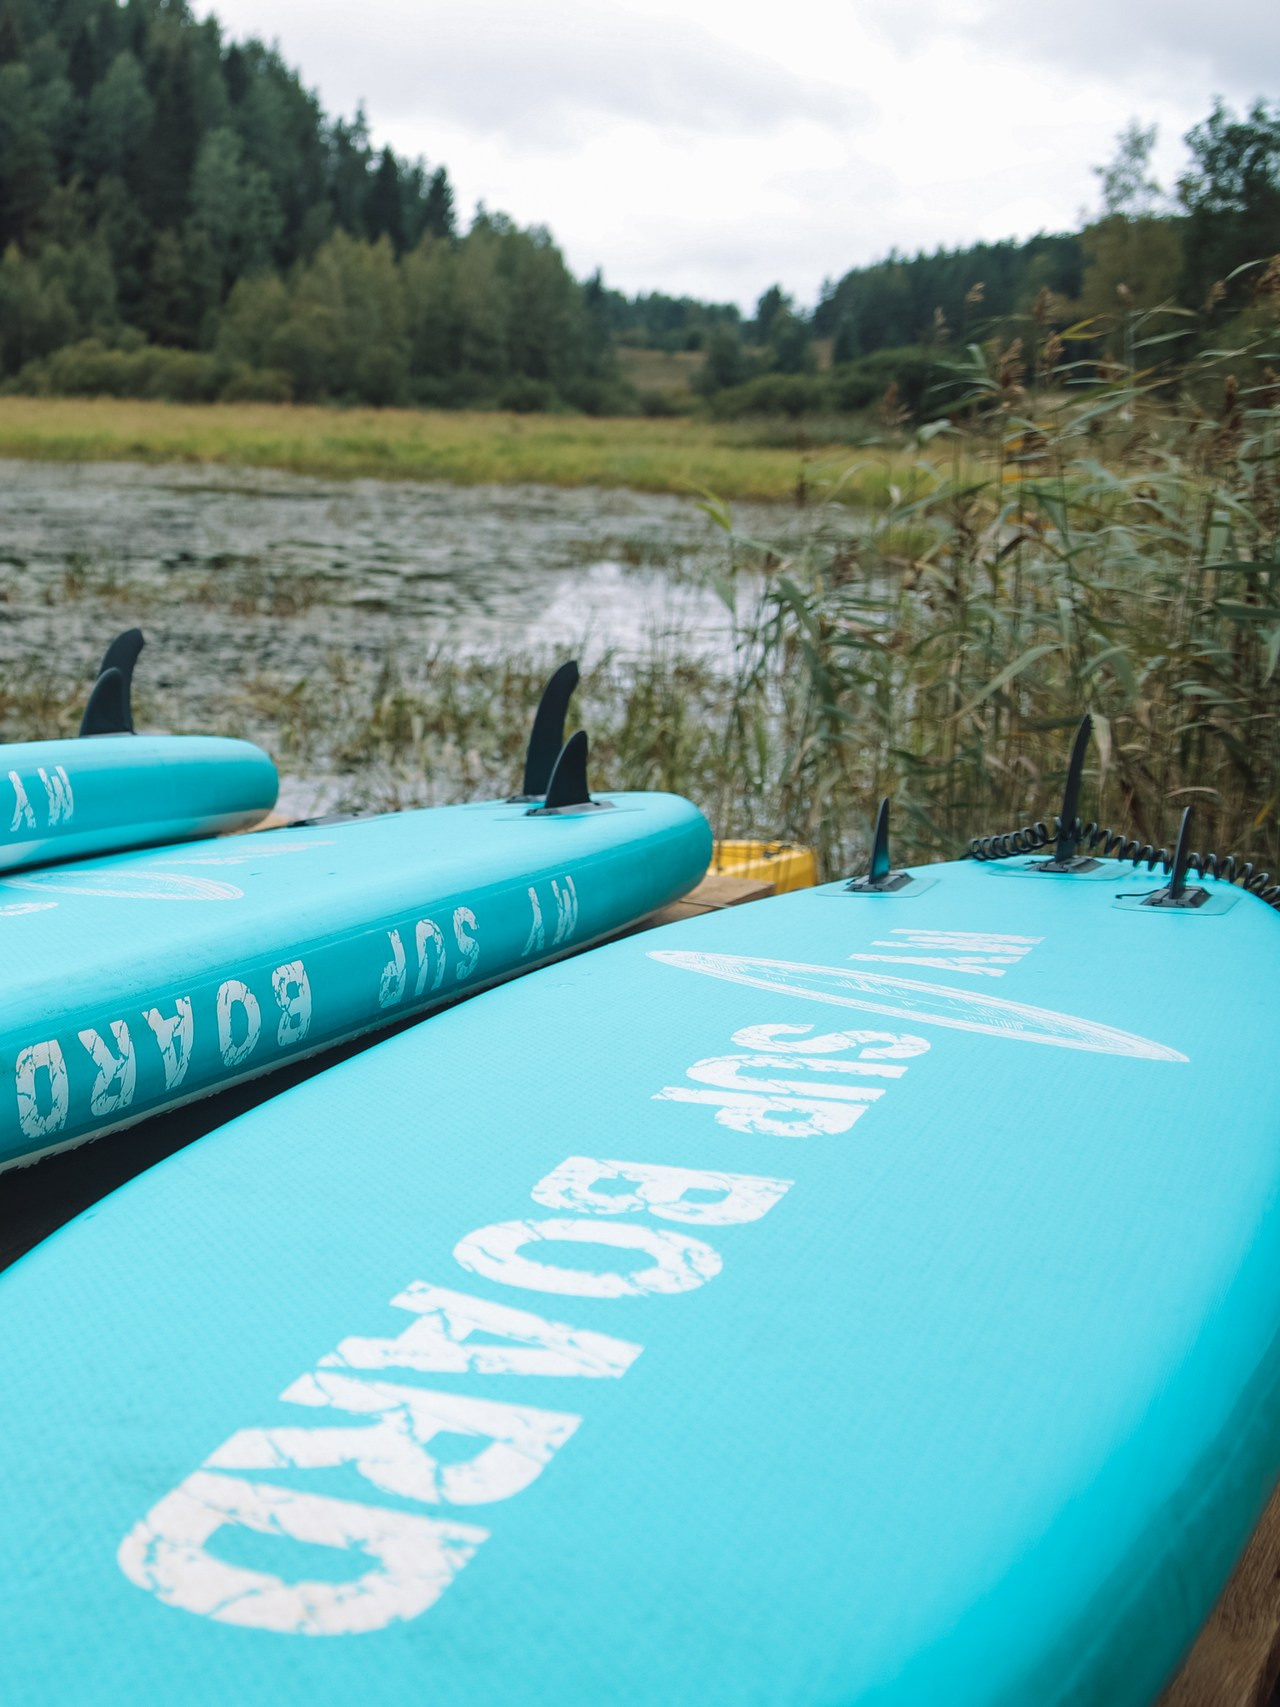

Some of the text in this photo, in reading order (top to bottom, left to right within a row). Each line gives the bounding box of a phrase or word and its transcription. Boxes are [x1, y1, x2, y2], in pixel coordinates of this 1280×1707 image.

[8, 765, 74, 832] MY
[15, 875, 579, 1139] MY SUP BOARD
[117, 928, 1045, 1635] MY SUP BOARD
